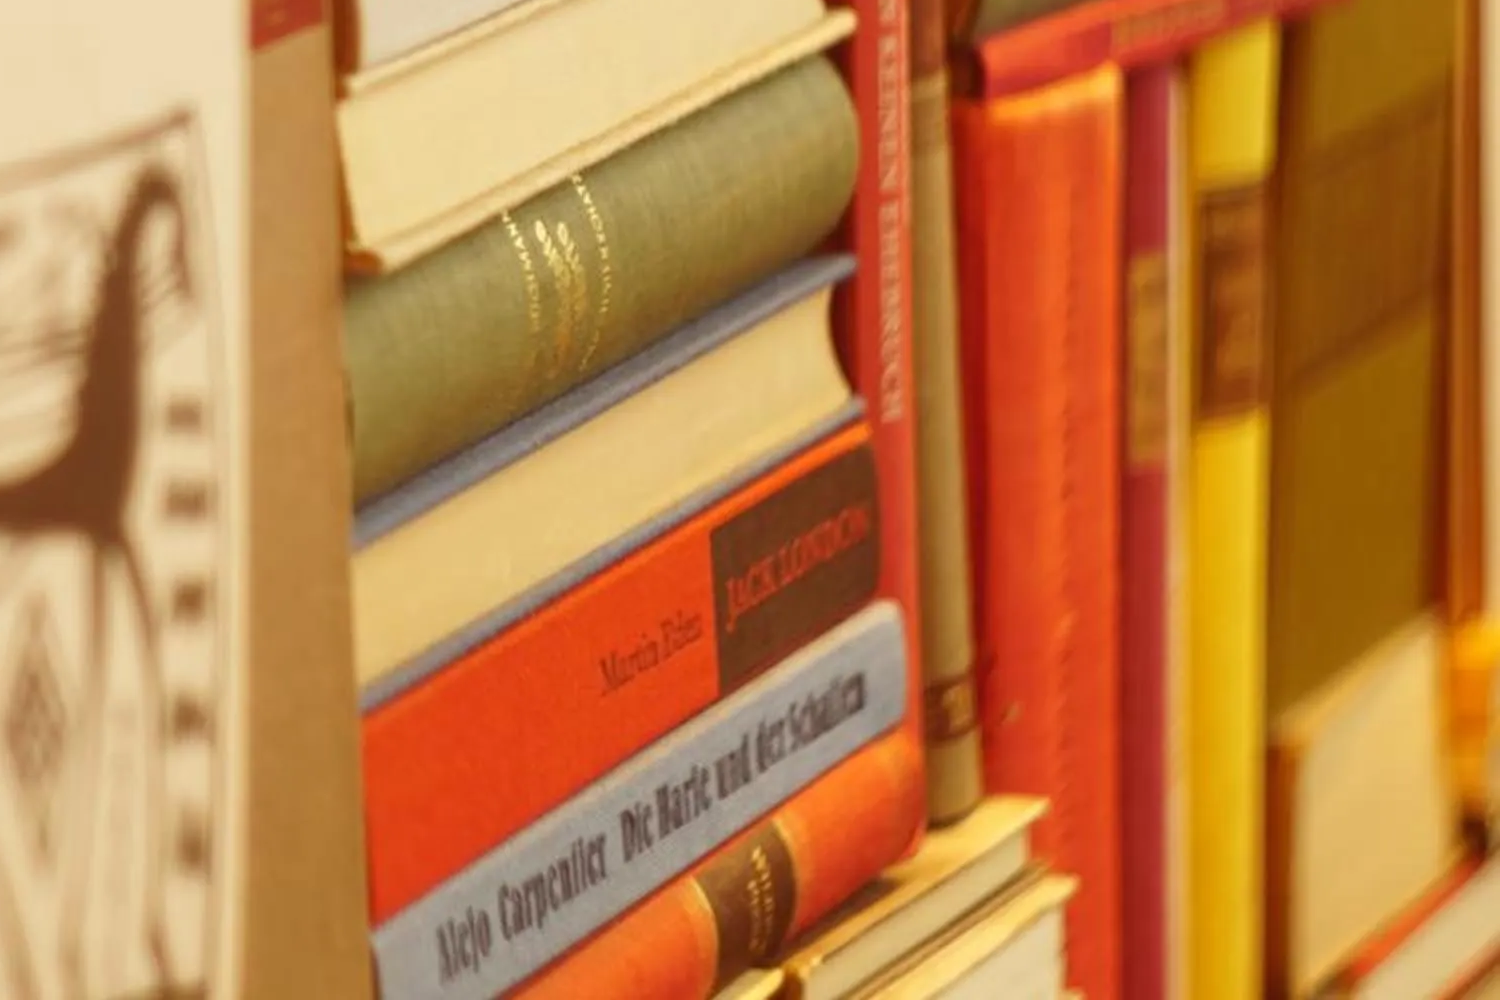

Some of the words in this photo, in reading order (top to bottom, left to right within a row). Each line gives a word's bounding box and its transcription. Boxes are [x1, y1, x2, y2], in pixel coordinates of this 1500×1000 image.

[877, 34, 901, 191] KEINEN
[779, 506, 871, 587] LONDON
[598, 632, 658, 698] Martin
[436, 905, 492, 988] Alejo
[497, 832, 607, 943] Carpentier
[620, 802, 654, 864] Die
[654, 764, 712, 840] Harfe
[715, 733, 751, 801] und
[755, 716, 788, 775] der
